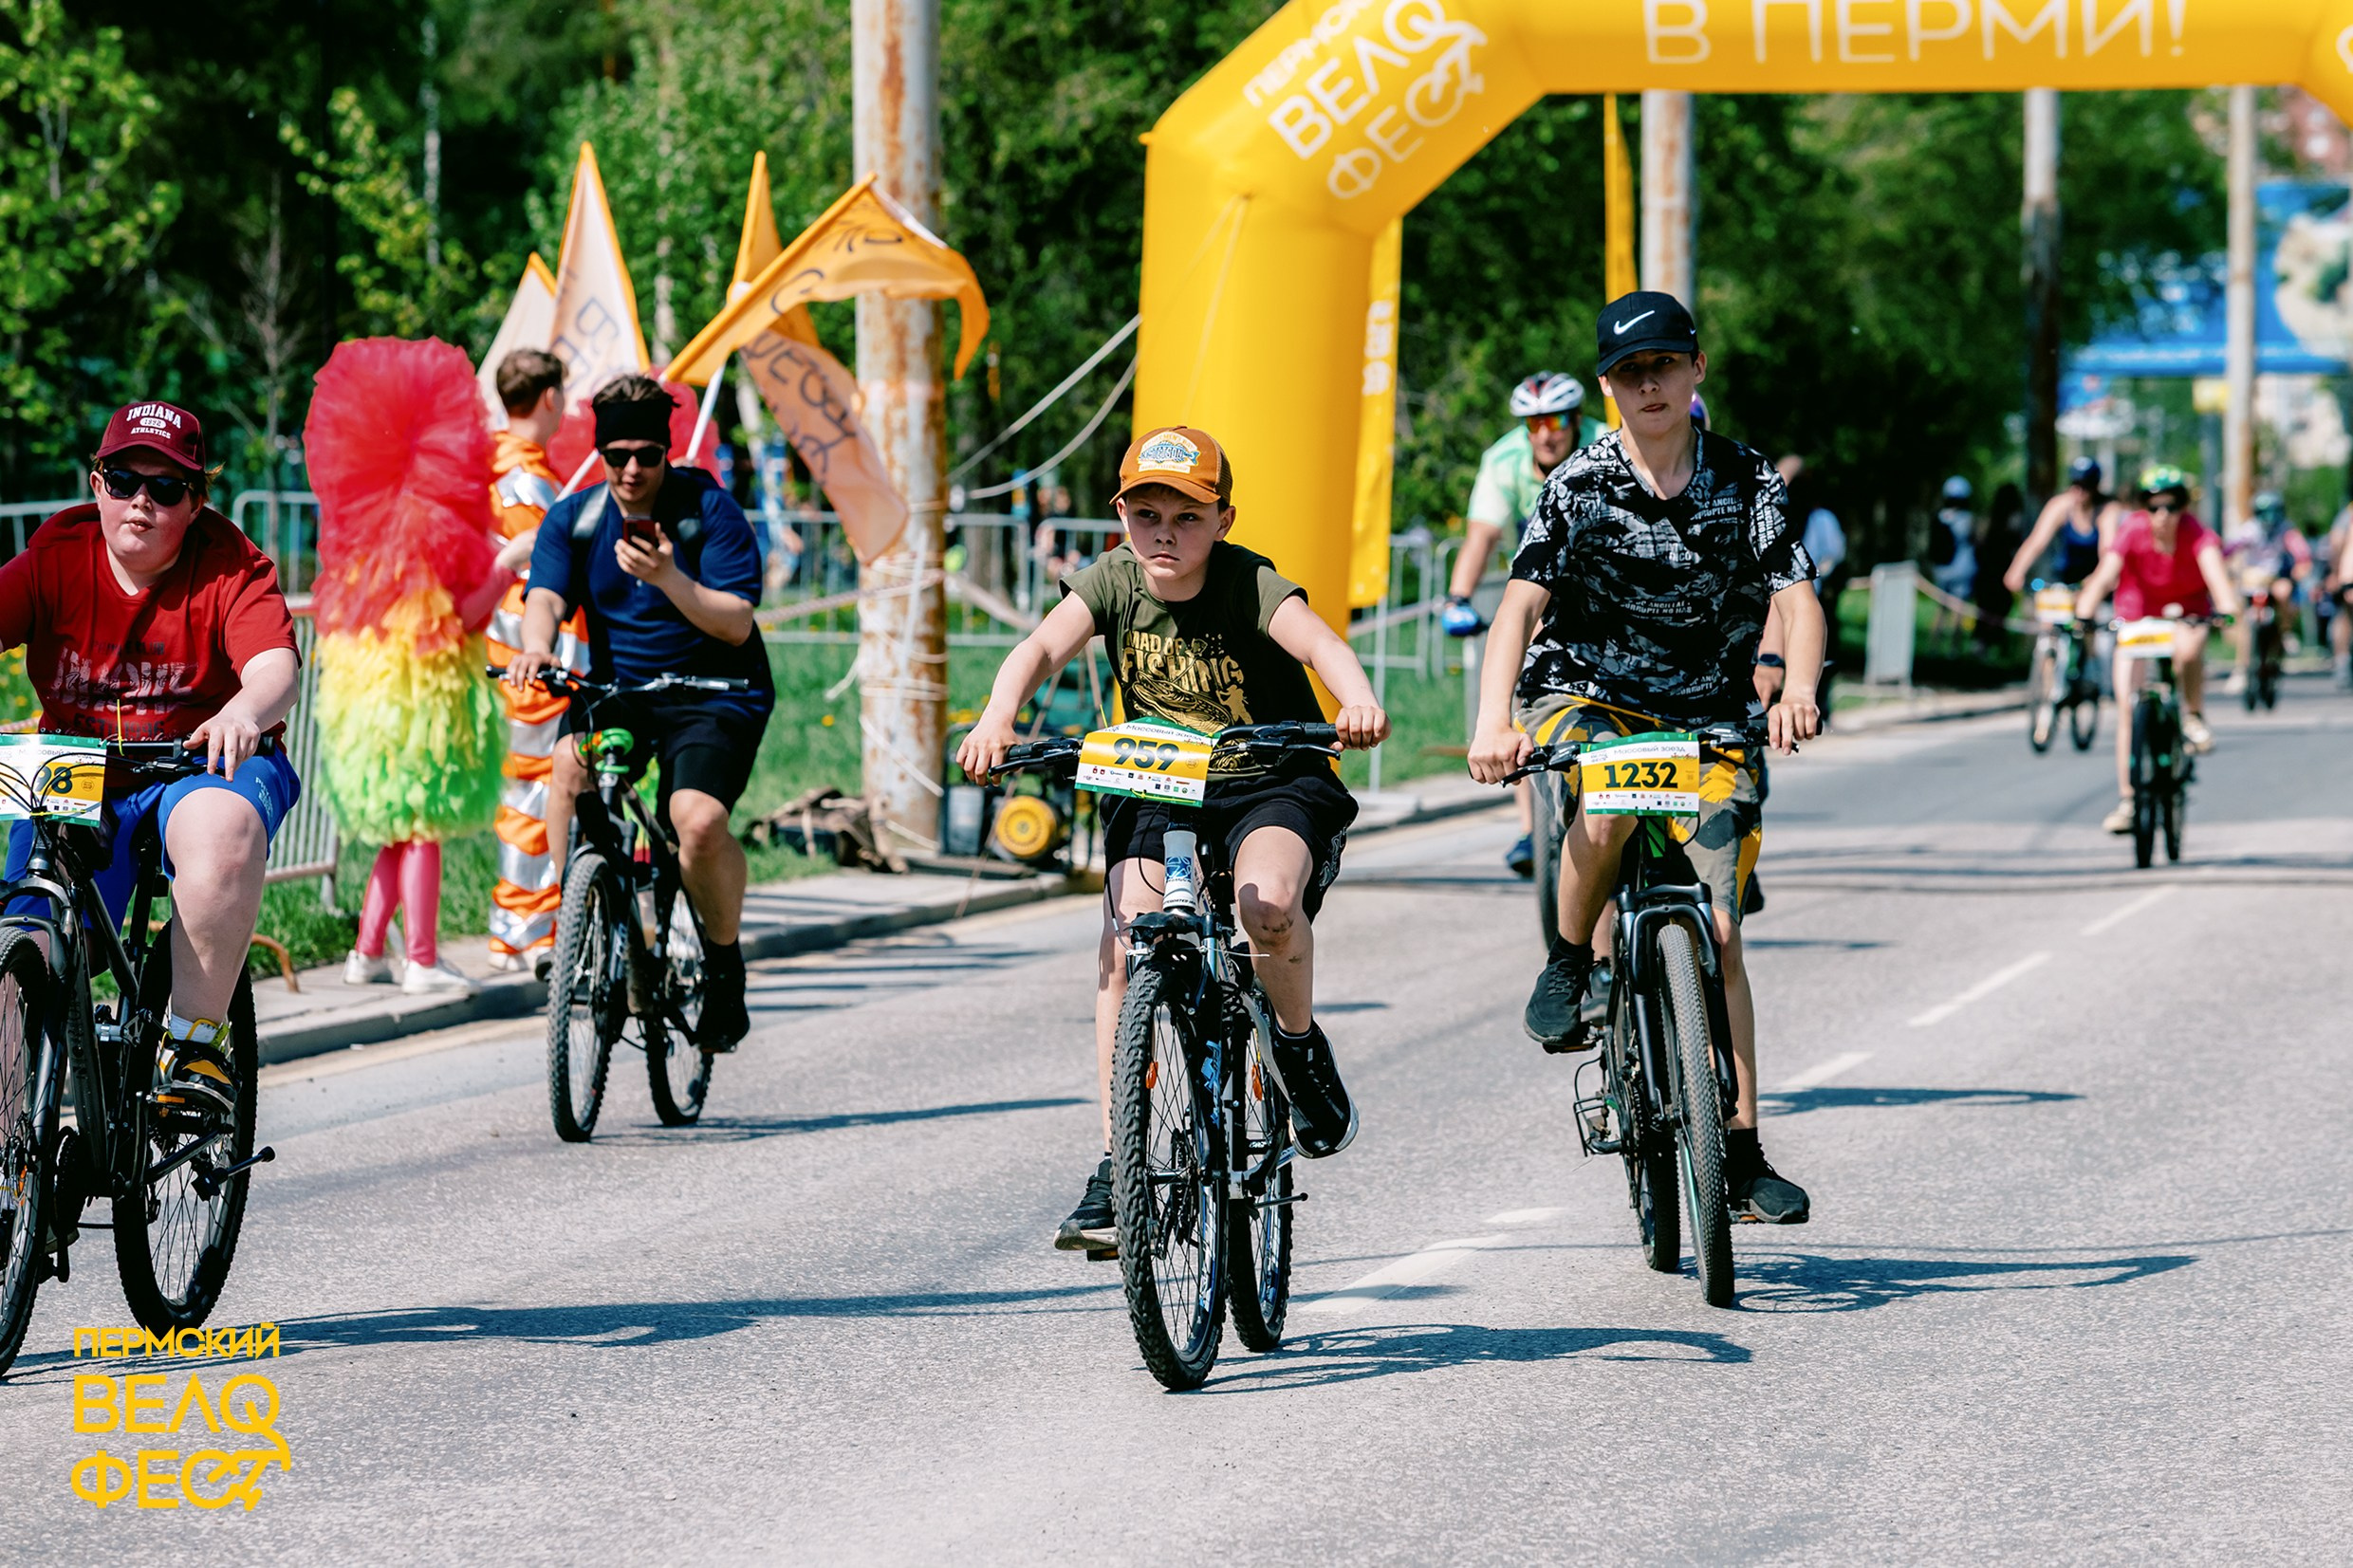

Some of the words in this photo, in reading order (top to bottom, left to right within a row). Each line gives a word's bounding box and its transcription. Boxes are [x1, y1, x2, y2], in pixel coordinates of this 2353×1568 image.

[1642, 0, 1711, 65] В
[1751, 0, 2186, 64] ПЕРМИ!
[126, 403, 181, 429] INDIANA
[131, 427, 172, 439] ATHLETICS
[1126, 630, 1162, 653] MAD
[1163, 636, 1183, 655] OF
[1121, 647, 1245, 692] FISHING
[1113, 737, 1180, 771] 959
[1603, 761, 1678, 789] 1232
